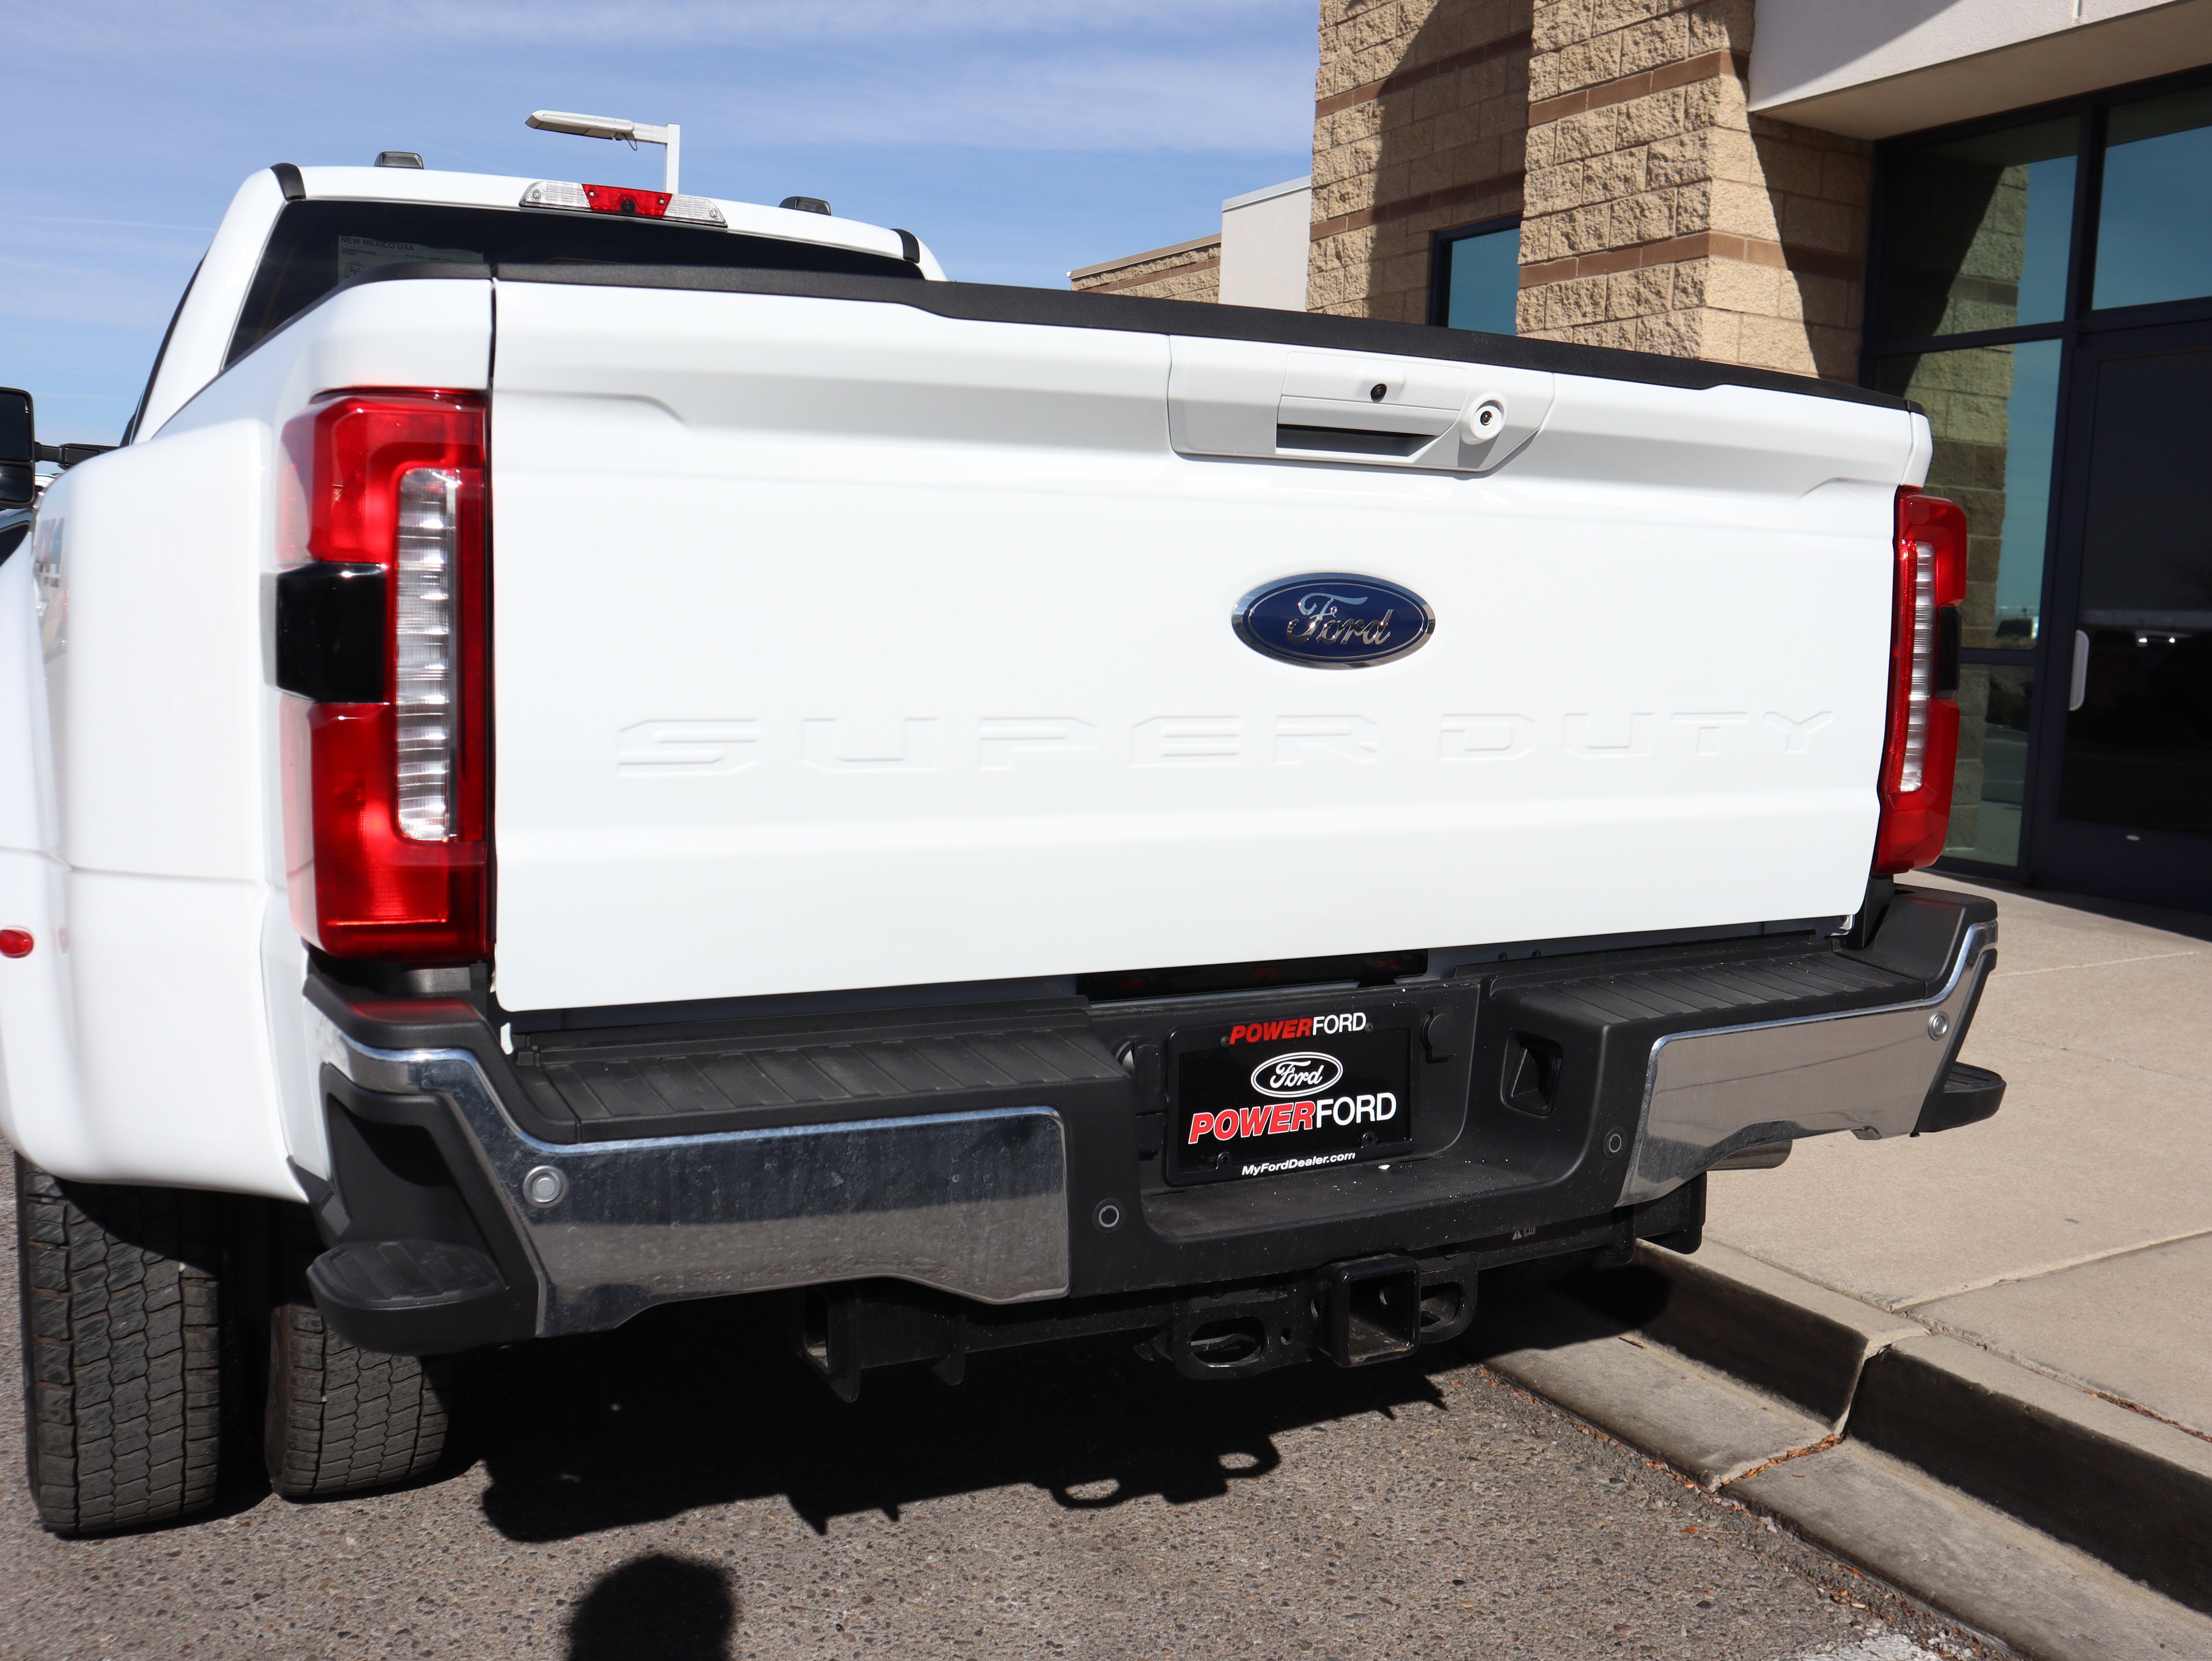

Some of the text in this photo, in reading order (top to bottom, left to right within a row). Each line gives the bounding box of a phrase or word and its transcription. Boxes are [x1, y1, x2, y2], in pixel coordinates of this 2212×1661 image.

[362, 239, 394, 248] MEXICO
[397, 243, 414, 251] USA
[1287, 592, 1395, 644] Ford
[616, 710, 1835, 777] SUPER DUTY
[1269, 1060, 1324, 1088] Ford
[1241, 1152, 1356, 1176] MyFordDealer.com
